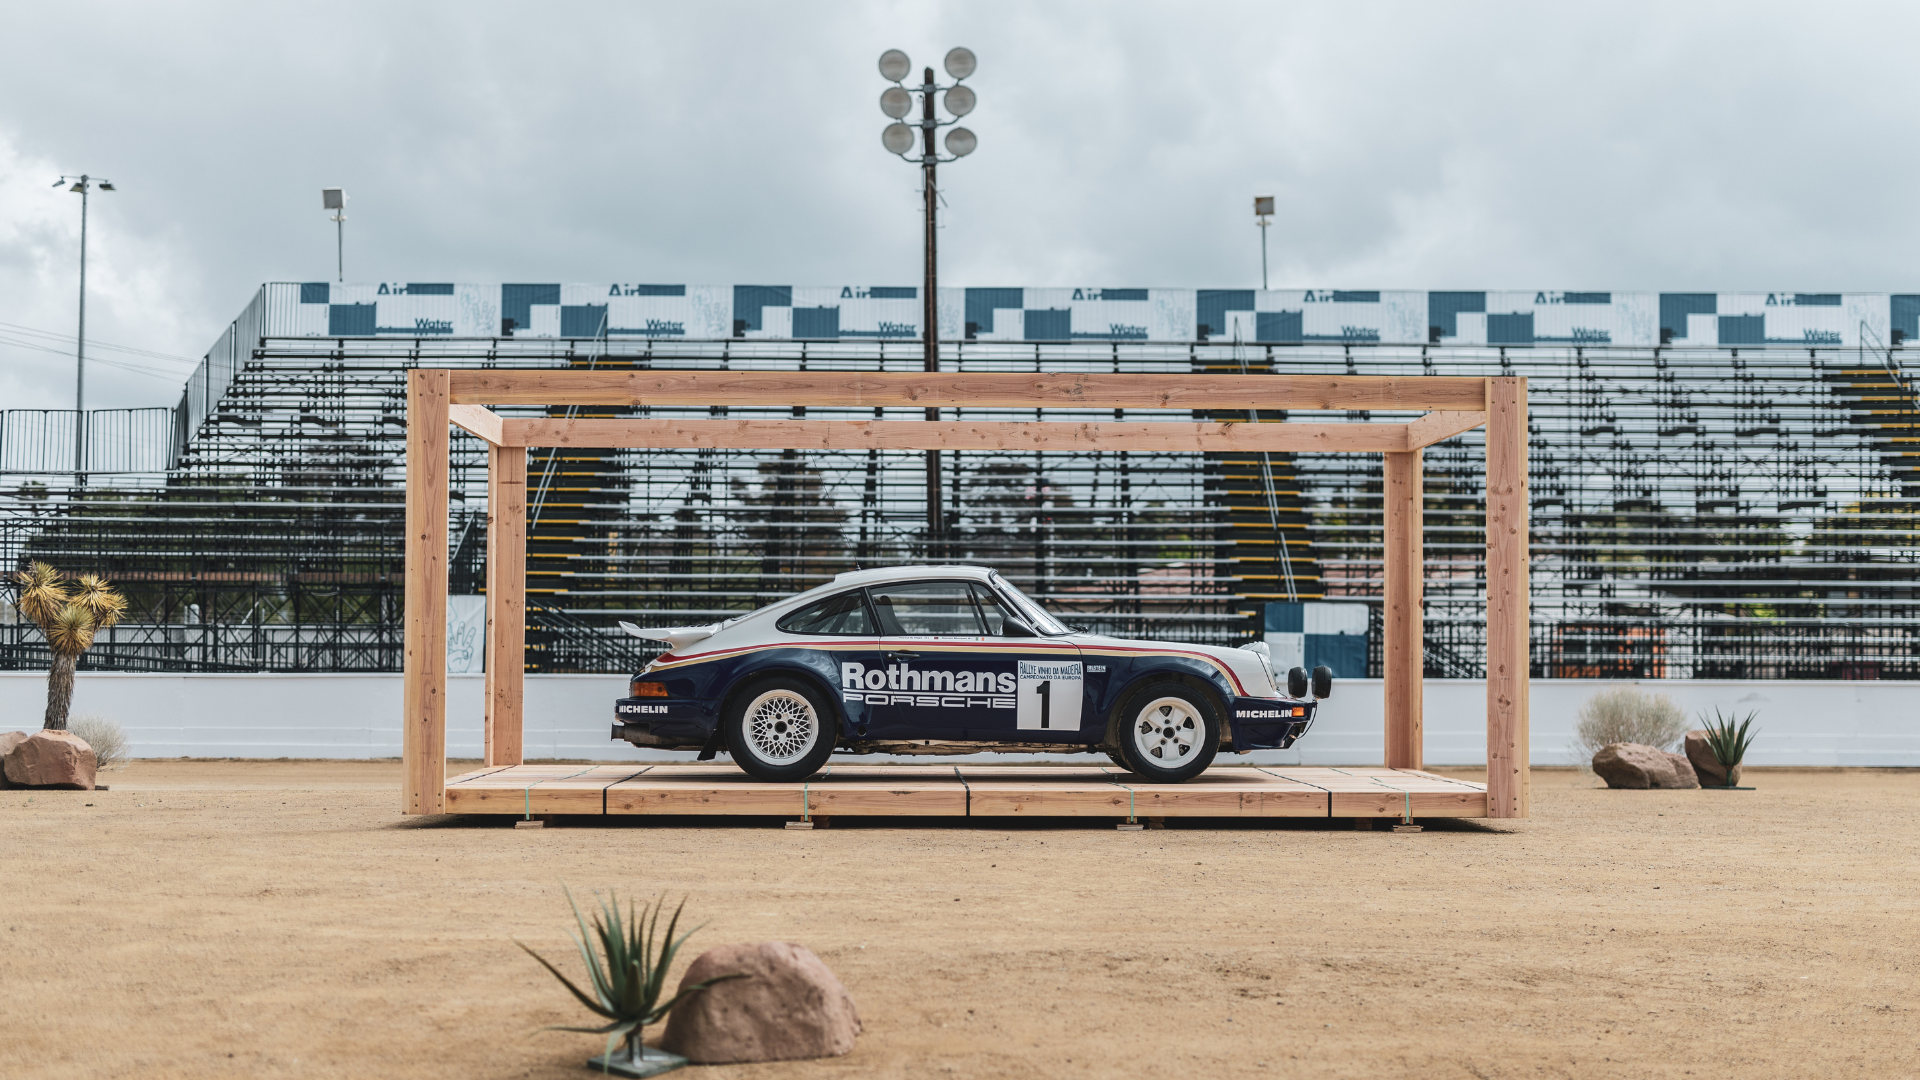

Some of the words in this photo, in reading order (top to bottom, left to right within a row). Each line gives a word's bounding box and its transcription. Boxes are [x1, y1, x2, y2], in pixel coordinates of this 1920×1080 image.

[377, 282, 408, 295] Air
[609, 283, 639, 296] Air
[840, 286, 871, 299] Air
[1072, 288, 1102, 301] Air
[1304, 290, 1334, 302] Air
[1535, 291, 1565, 304] Air
[1766, 293, 1796, 306] Air
[415, 318, 453, 329] Water
[646, 319, 684, 330] Water
[878, 321, 916, 332] Water
[1110, 323, 1148, 335] Water
[1342, 325, 1379, 337] Water
[1572, 327, 1611, 339] Water
[1020, 661, 1036, 675] RALLYE
[1038, 665, 1051, 675] VINHO
[1053, 666, 1059, 675] DA
[1060, 662, 1082, 675] MADEIRA
[842, 662, 1016, 692] Rothmans
[843, 693, 1016, 709] PORSCHE
[1036, 680, 1050, 729] 1
[619, 705, 668, 714] MICHELIN
[1236, 709, 1292, 718] MICHELIN
